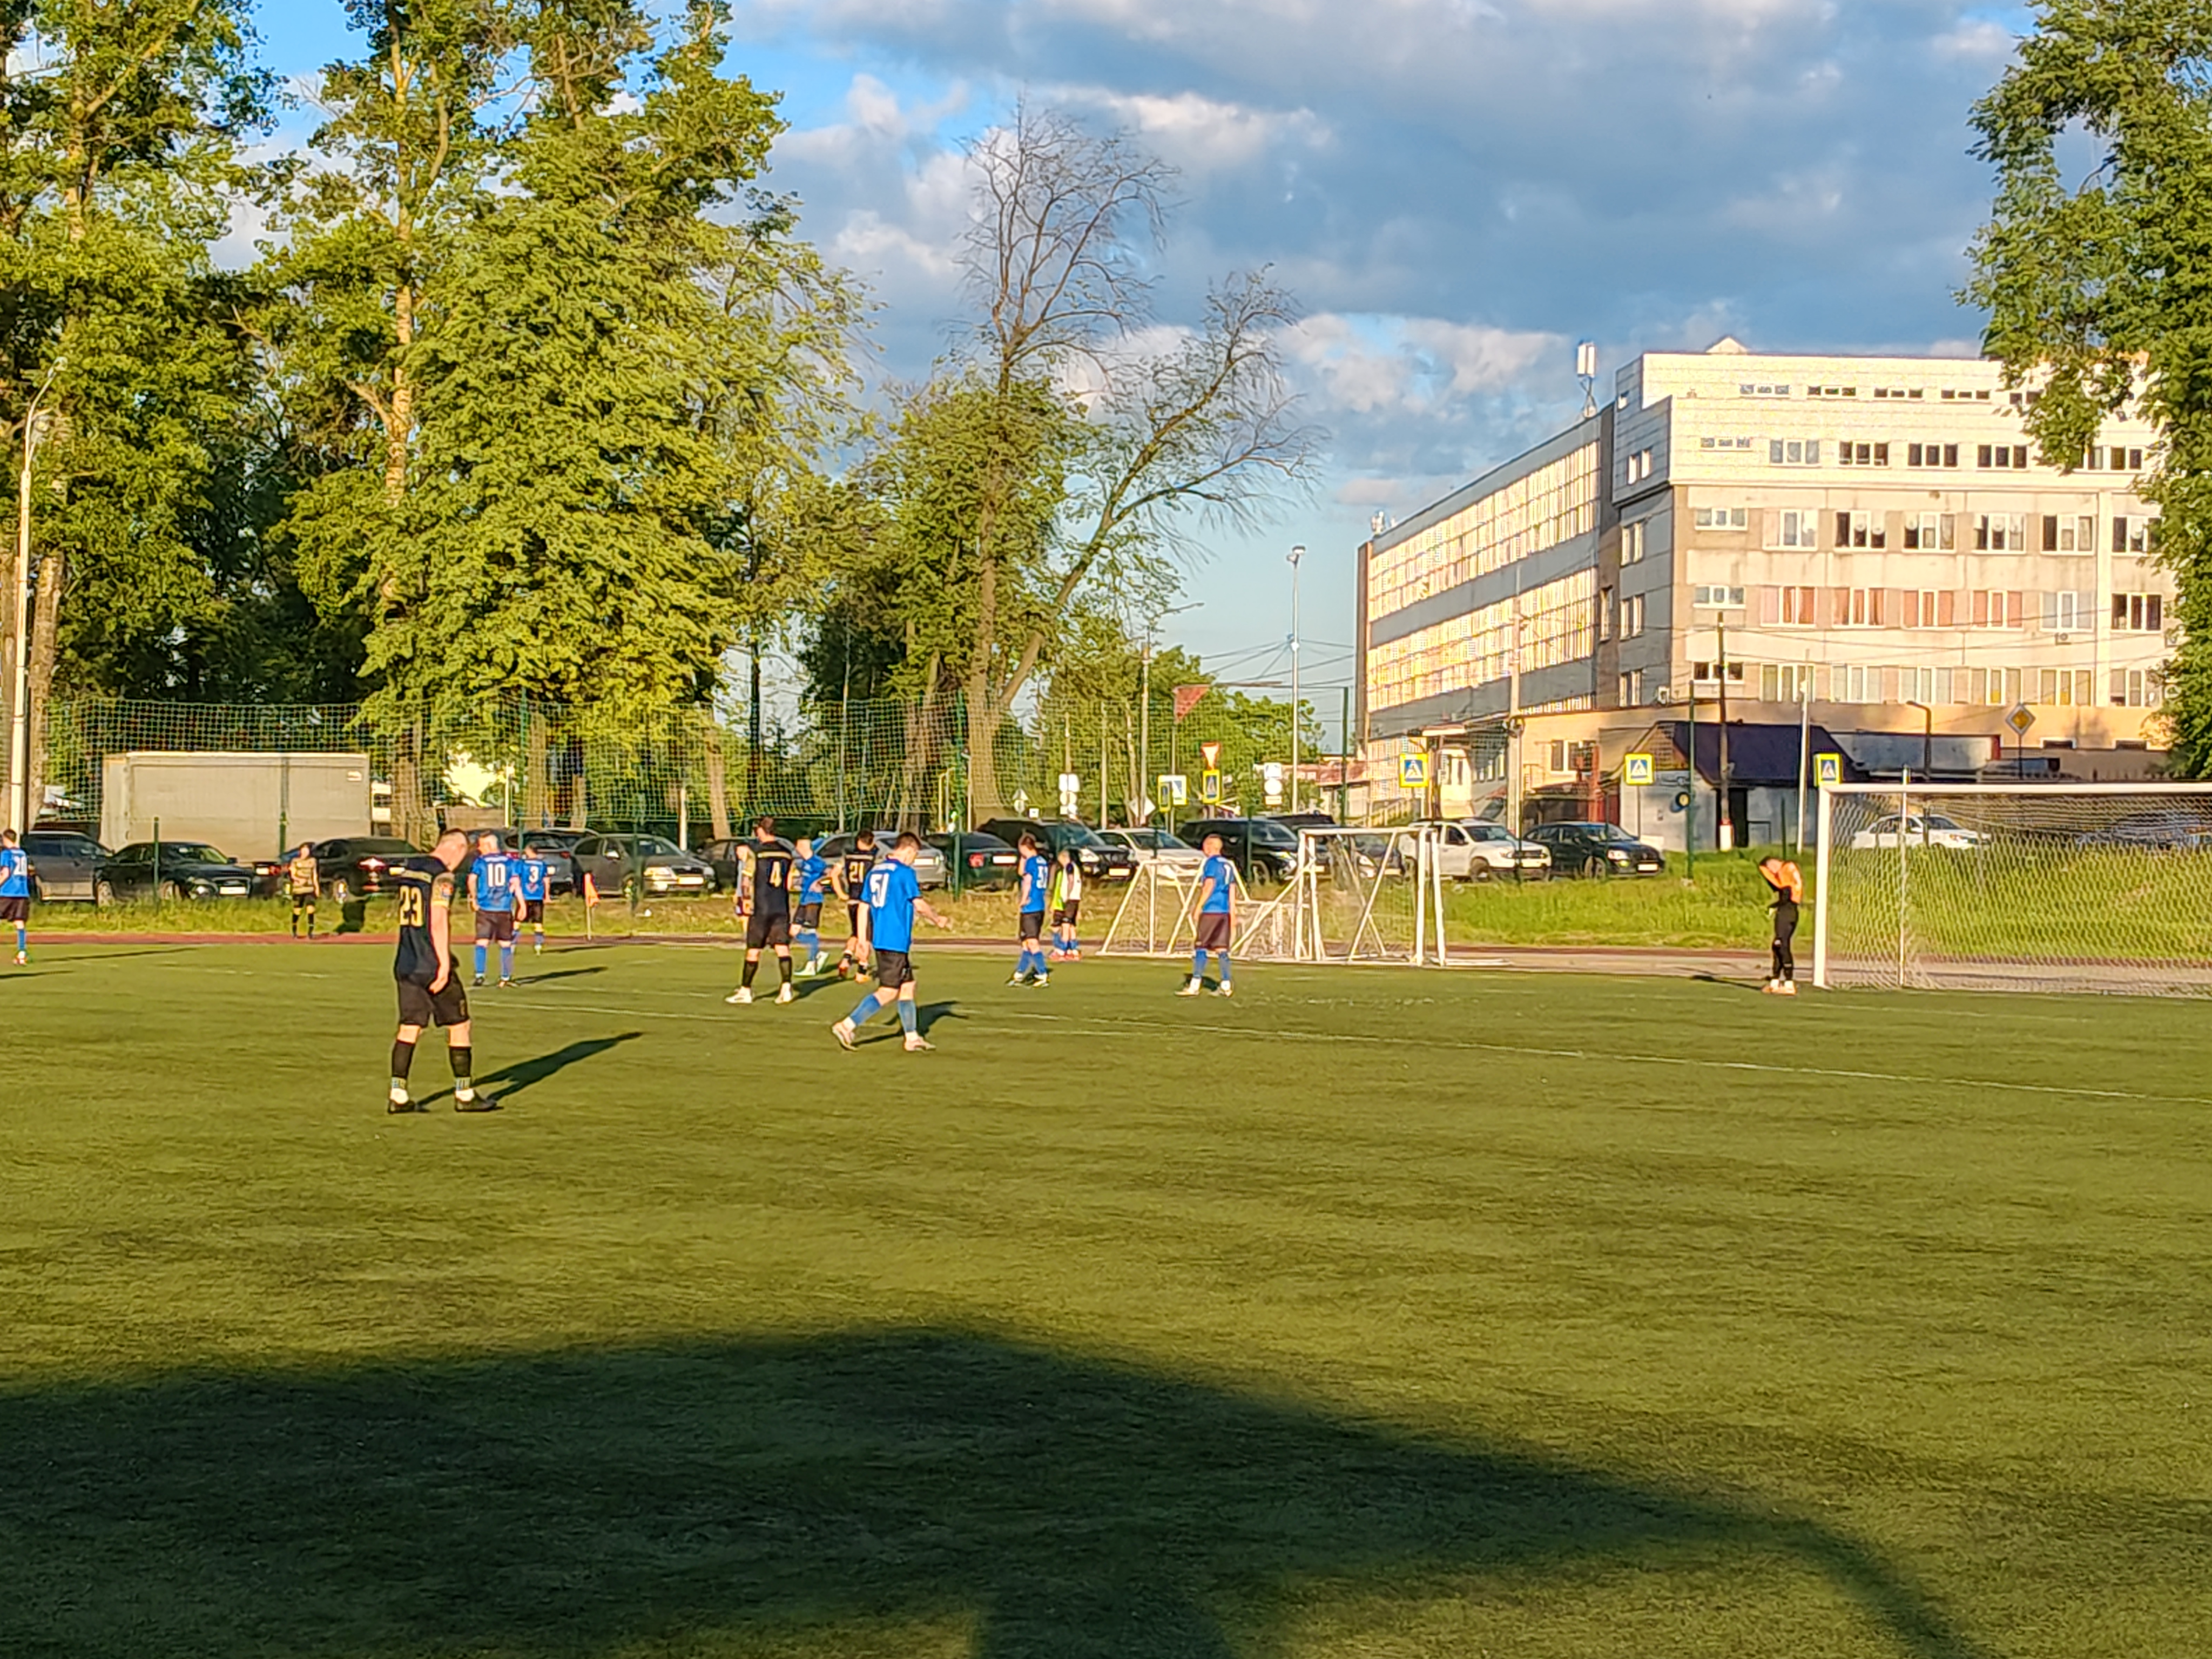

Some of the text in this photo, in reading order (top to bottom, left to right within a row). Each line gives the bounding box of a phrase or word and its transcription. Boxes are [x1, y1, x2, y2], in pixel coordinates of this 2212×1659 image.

[488, 863, 505, 887] 10
[529, 865, 539, 883] 3
[770, 861, 782, 887] 4
[849, 861, 864, 883] 21
[870, 873, 889, 908] 51
[400, 885, 422, 926] 23
